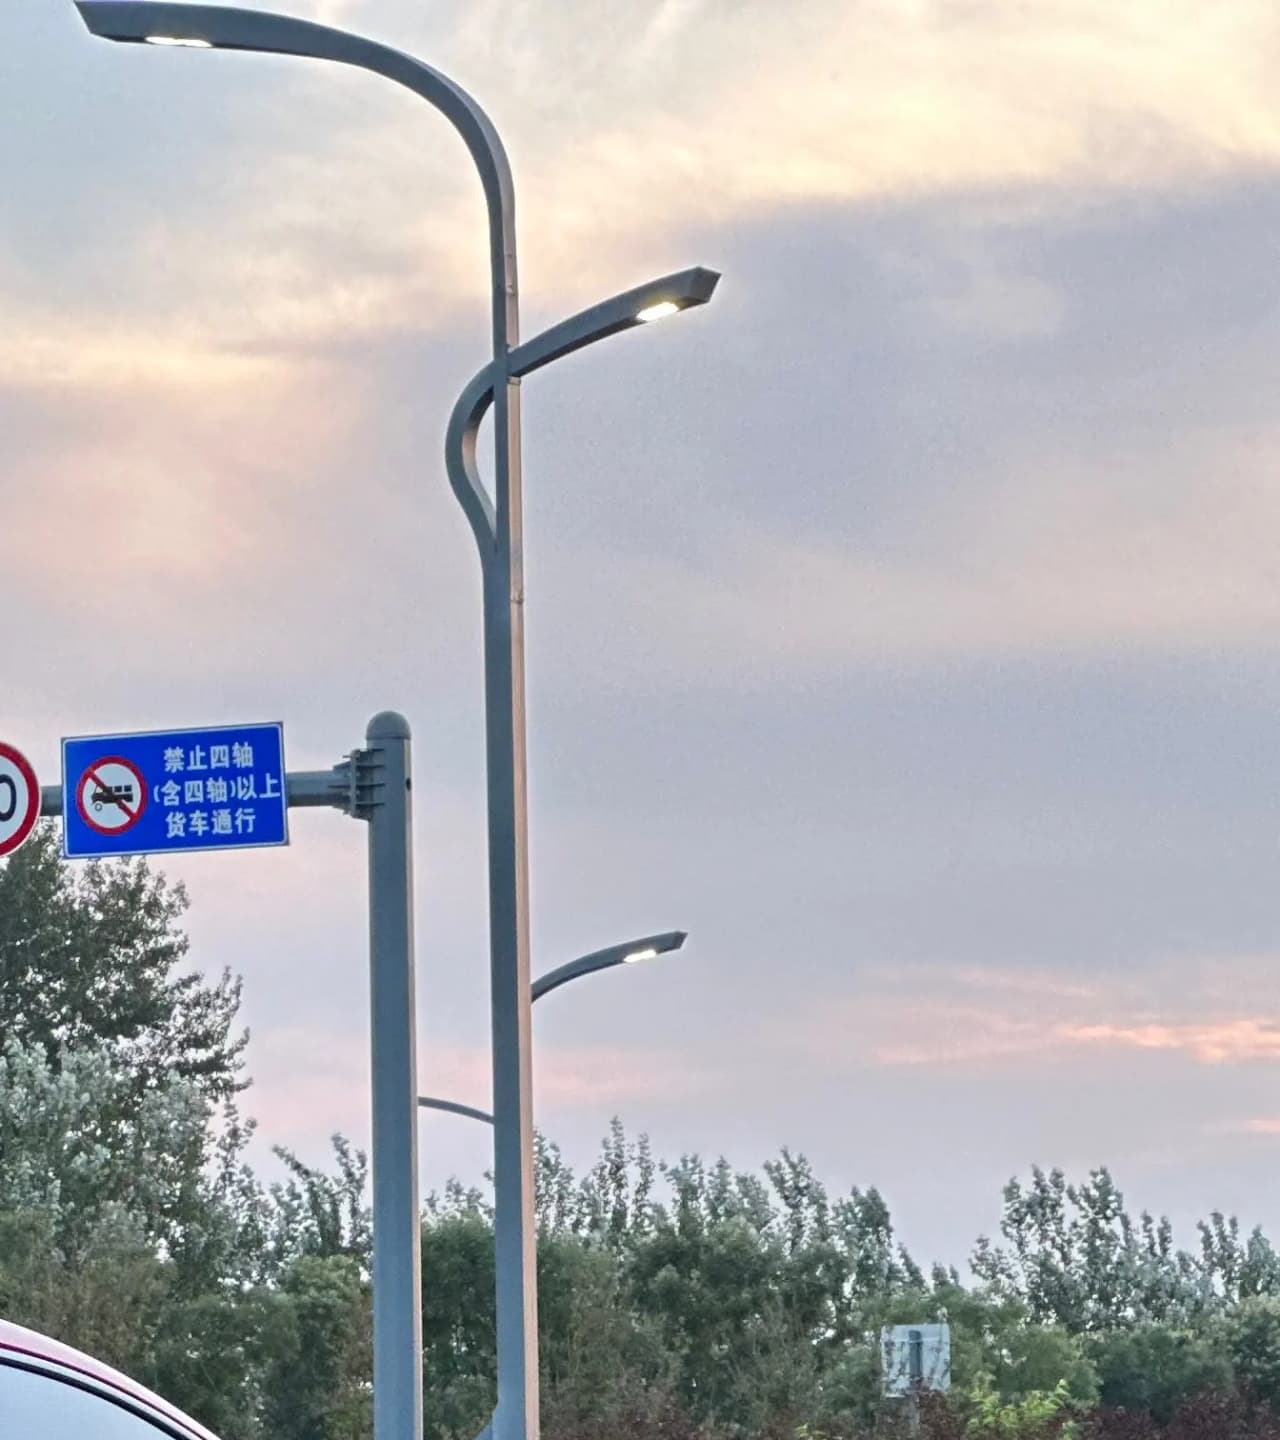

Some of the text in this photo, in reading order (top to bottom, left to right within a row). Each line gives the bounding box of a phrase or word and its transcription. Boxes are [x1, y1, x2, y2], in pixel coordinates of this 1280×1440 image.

[163, 741, 254, 773] 禁止四轴
[165, 807, 256, 838] 货车通行
